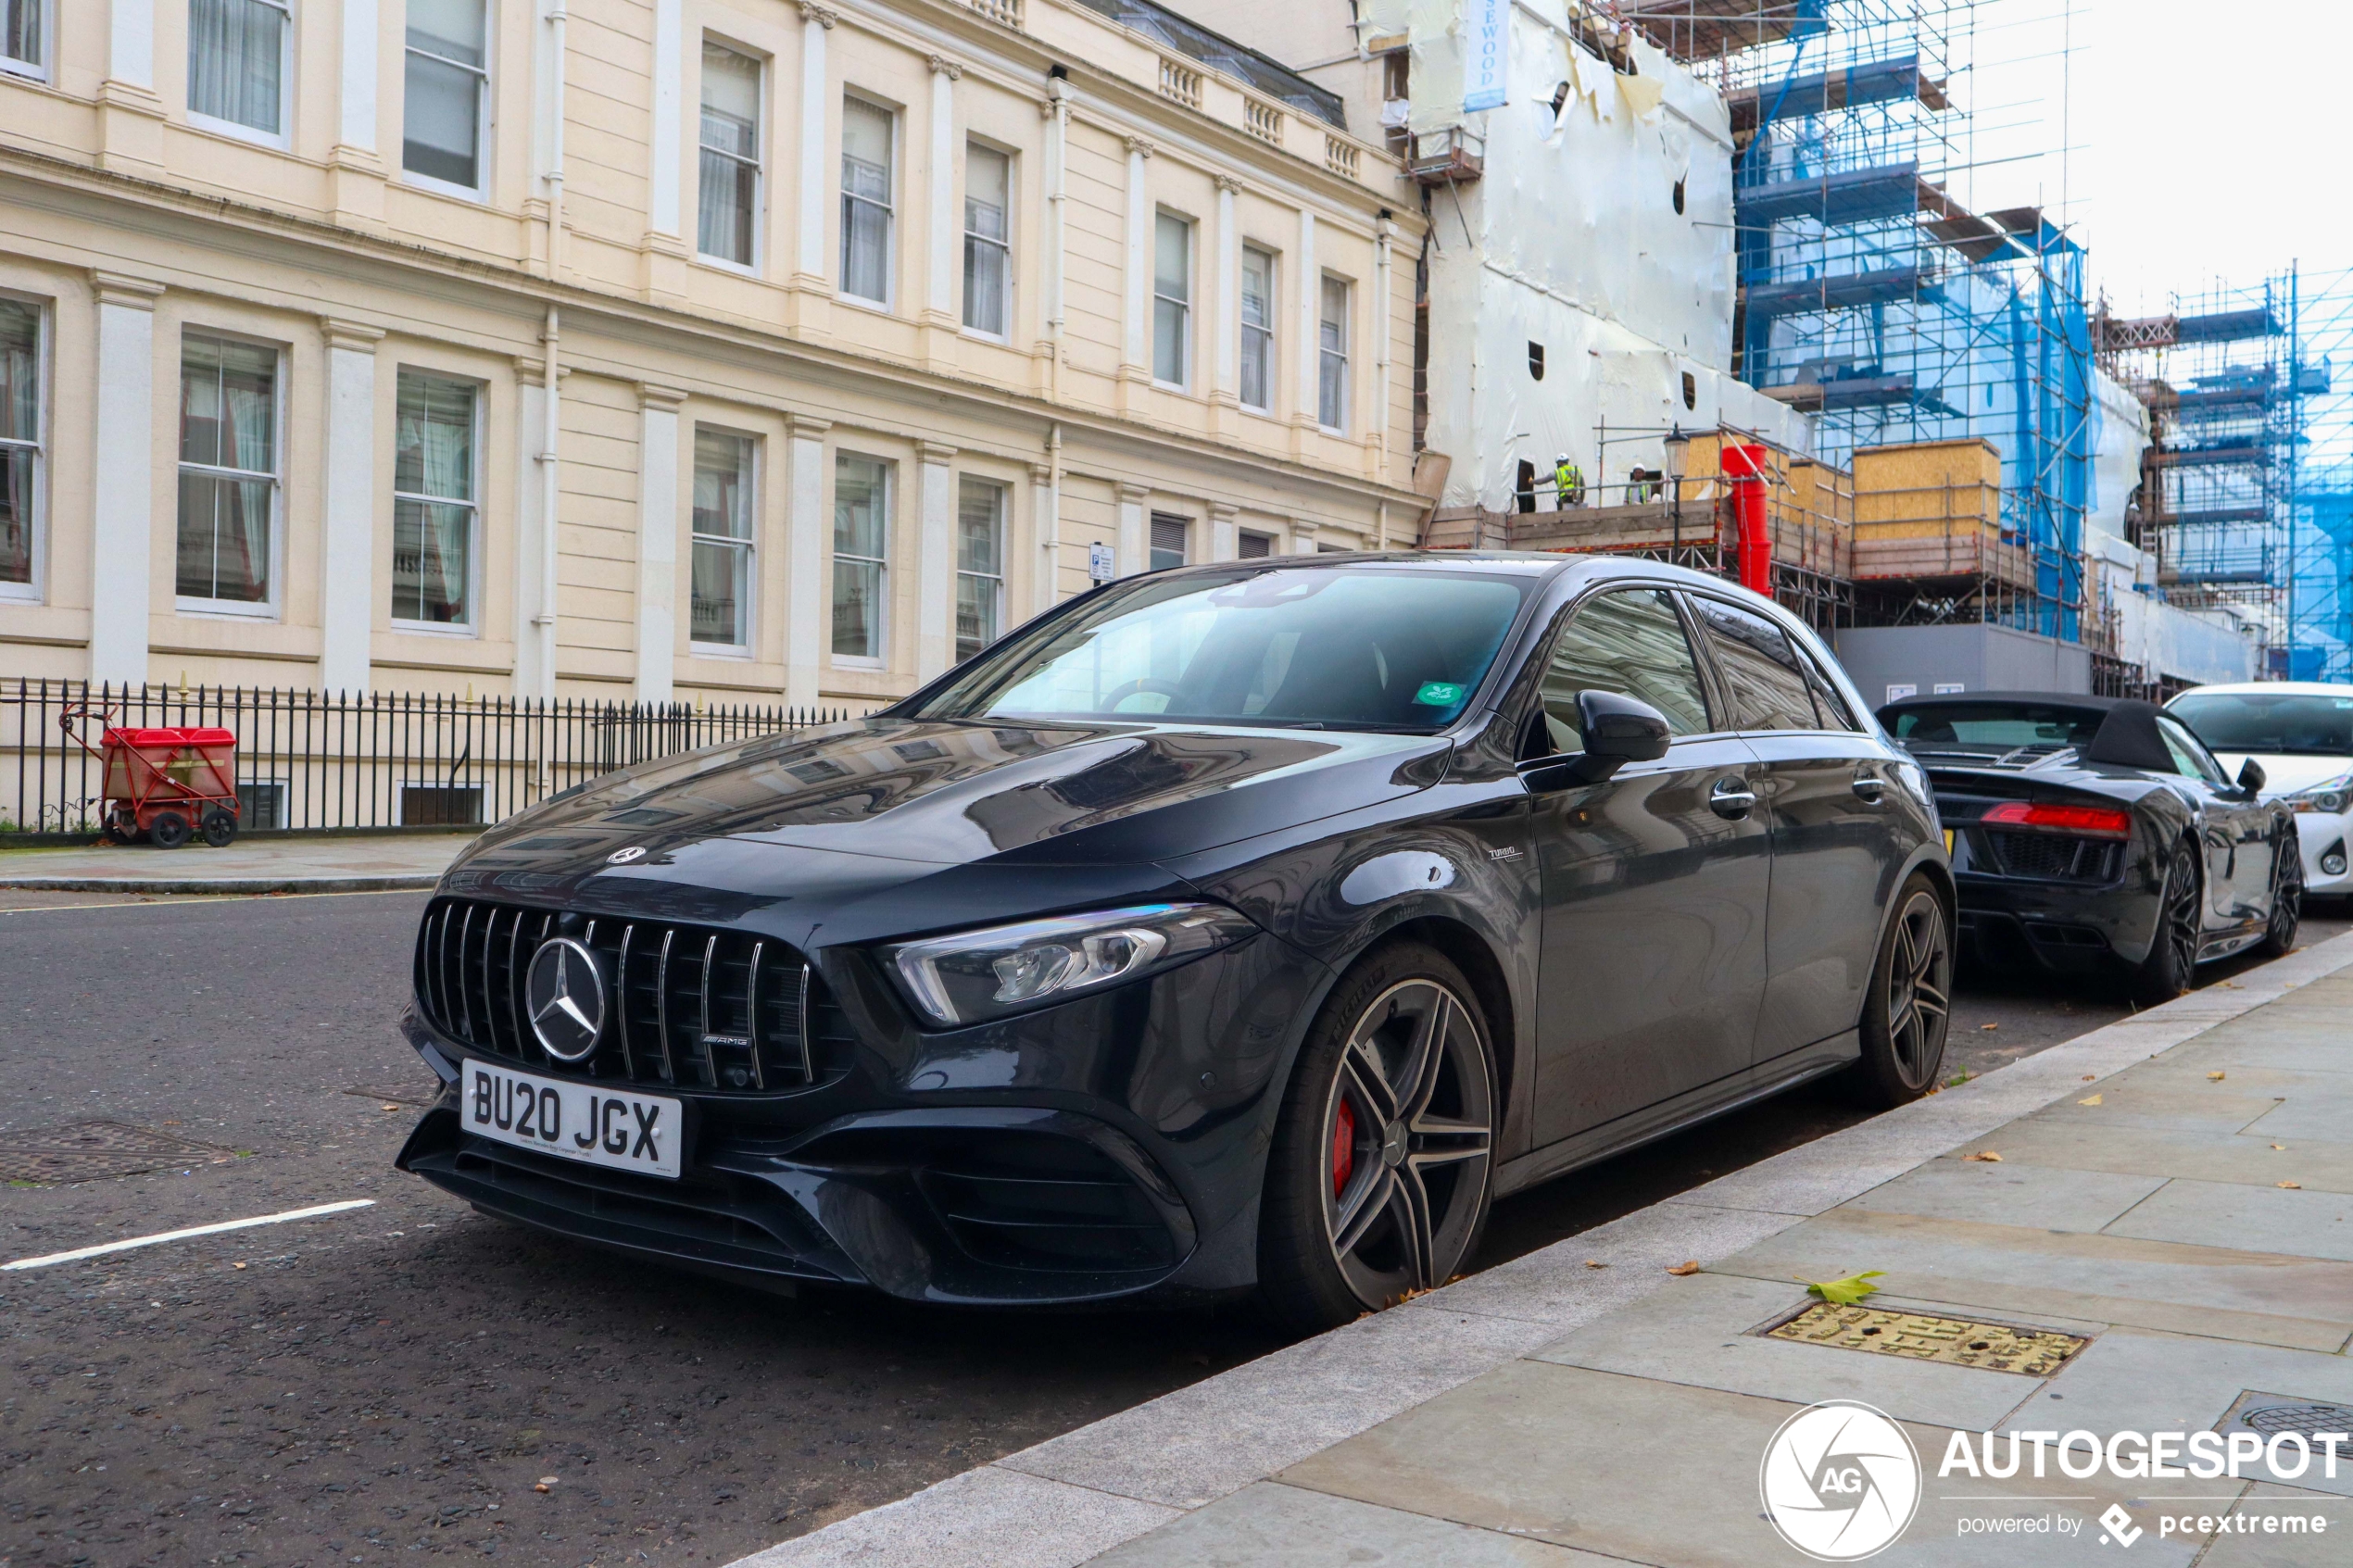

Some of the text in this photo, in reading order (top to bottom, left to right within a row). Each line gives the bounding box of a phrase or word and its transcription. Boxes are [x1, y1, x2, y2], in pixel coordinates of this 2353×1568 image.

[1489, 846, 1516, 858] TURBO
[717, 1037, 748, 1046] AMG
[474, 1070, 660, 1162] BU20 JGX
